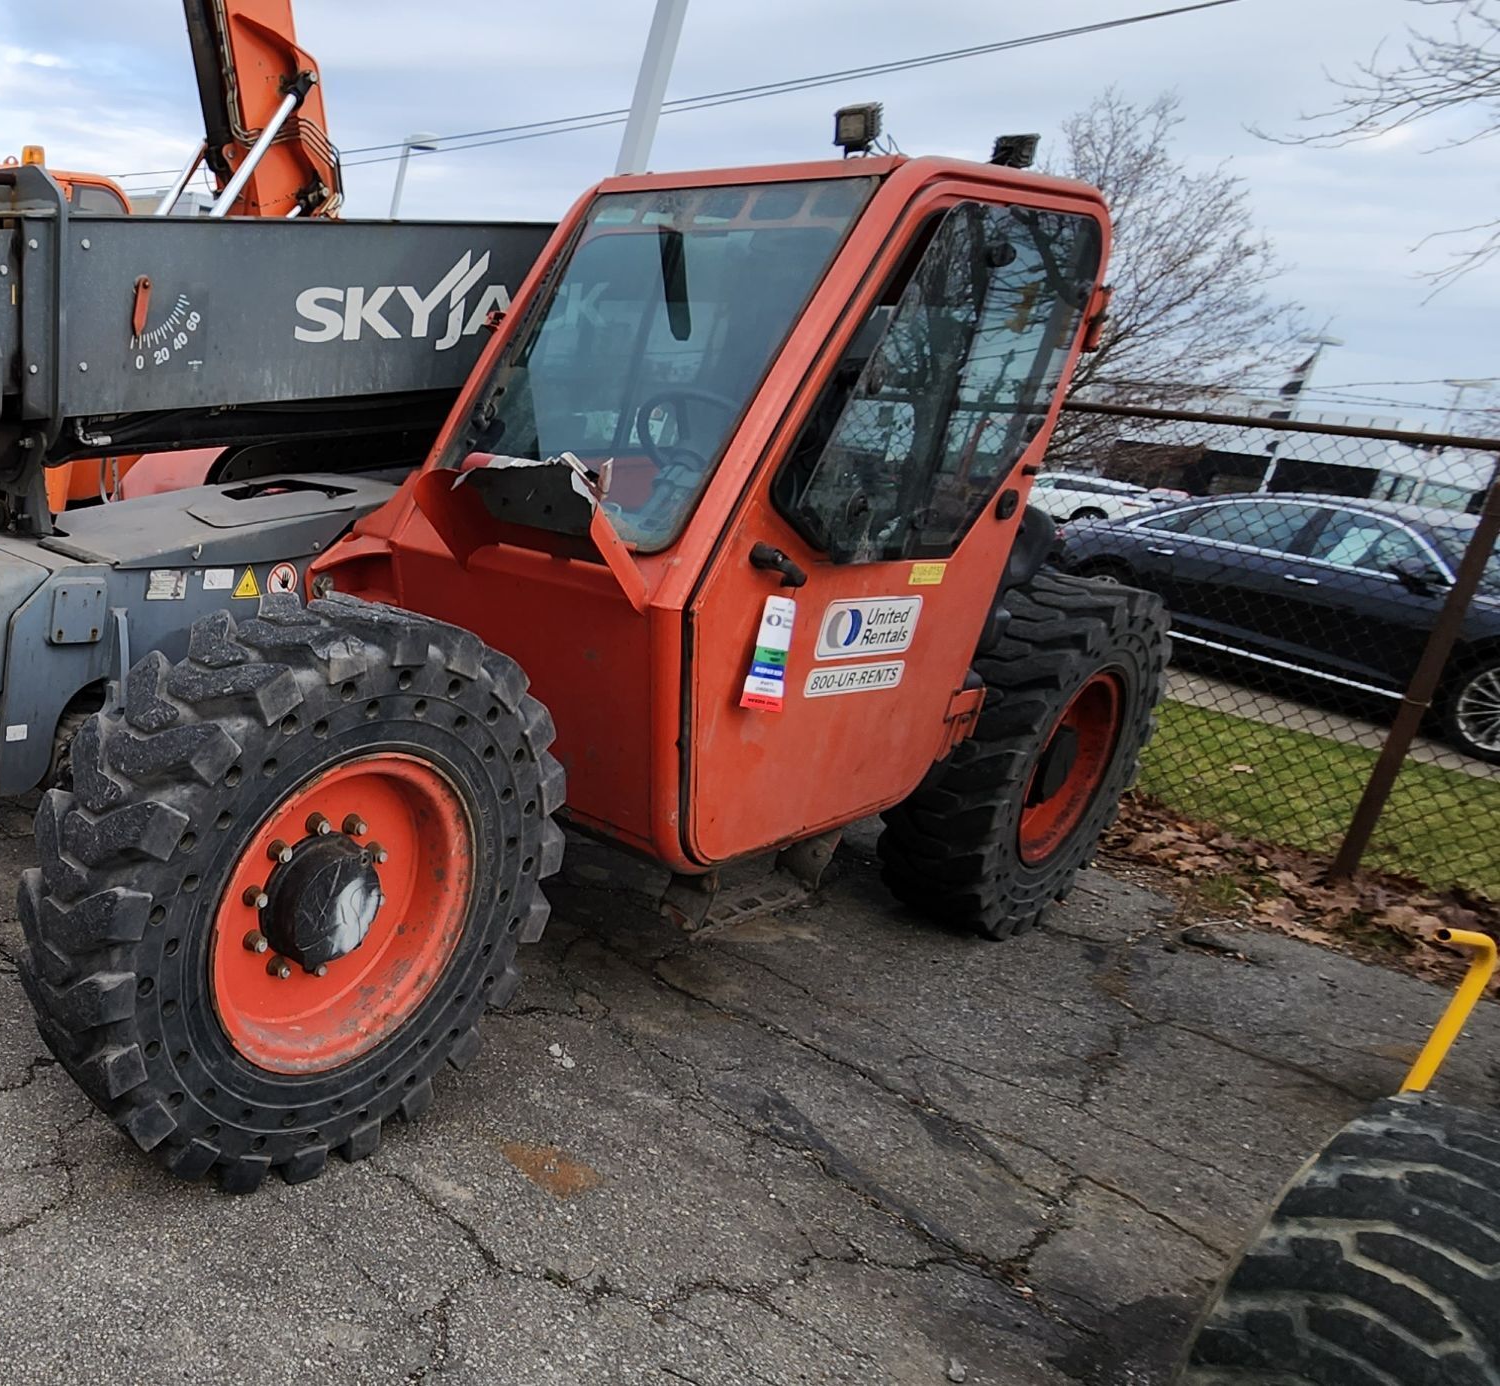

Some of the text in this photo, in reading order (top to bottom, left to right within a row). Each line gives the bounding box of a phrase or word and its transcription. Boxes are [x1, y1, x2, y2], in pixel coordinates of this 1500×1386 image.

[135, 311, 201, 370] 0 20 40 60
[866, 605, 913, 626] United
[859, 626, 908, 646] Rentals
[810, 667, 899, 691] 800-UR-RENTS
